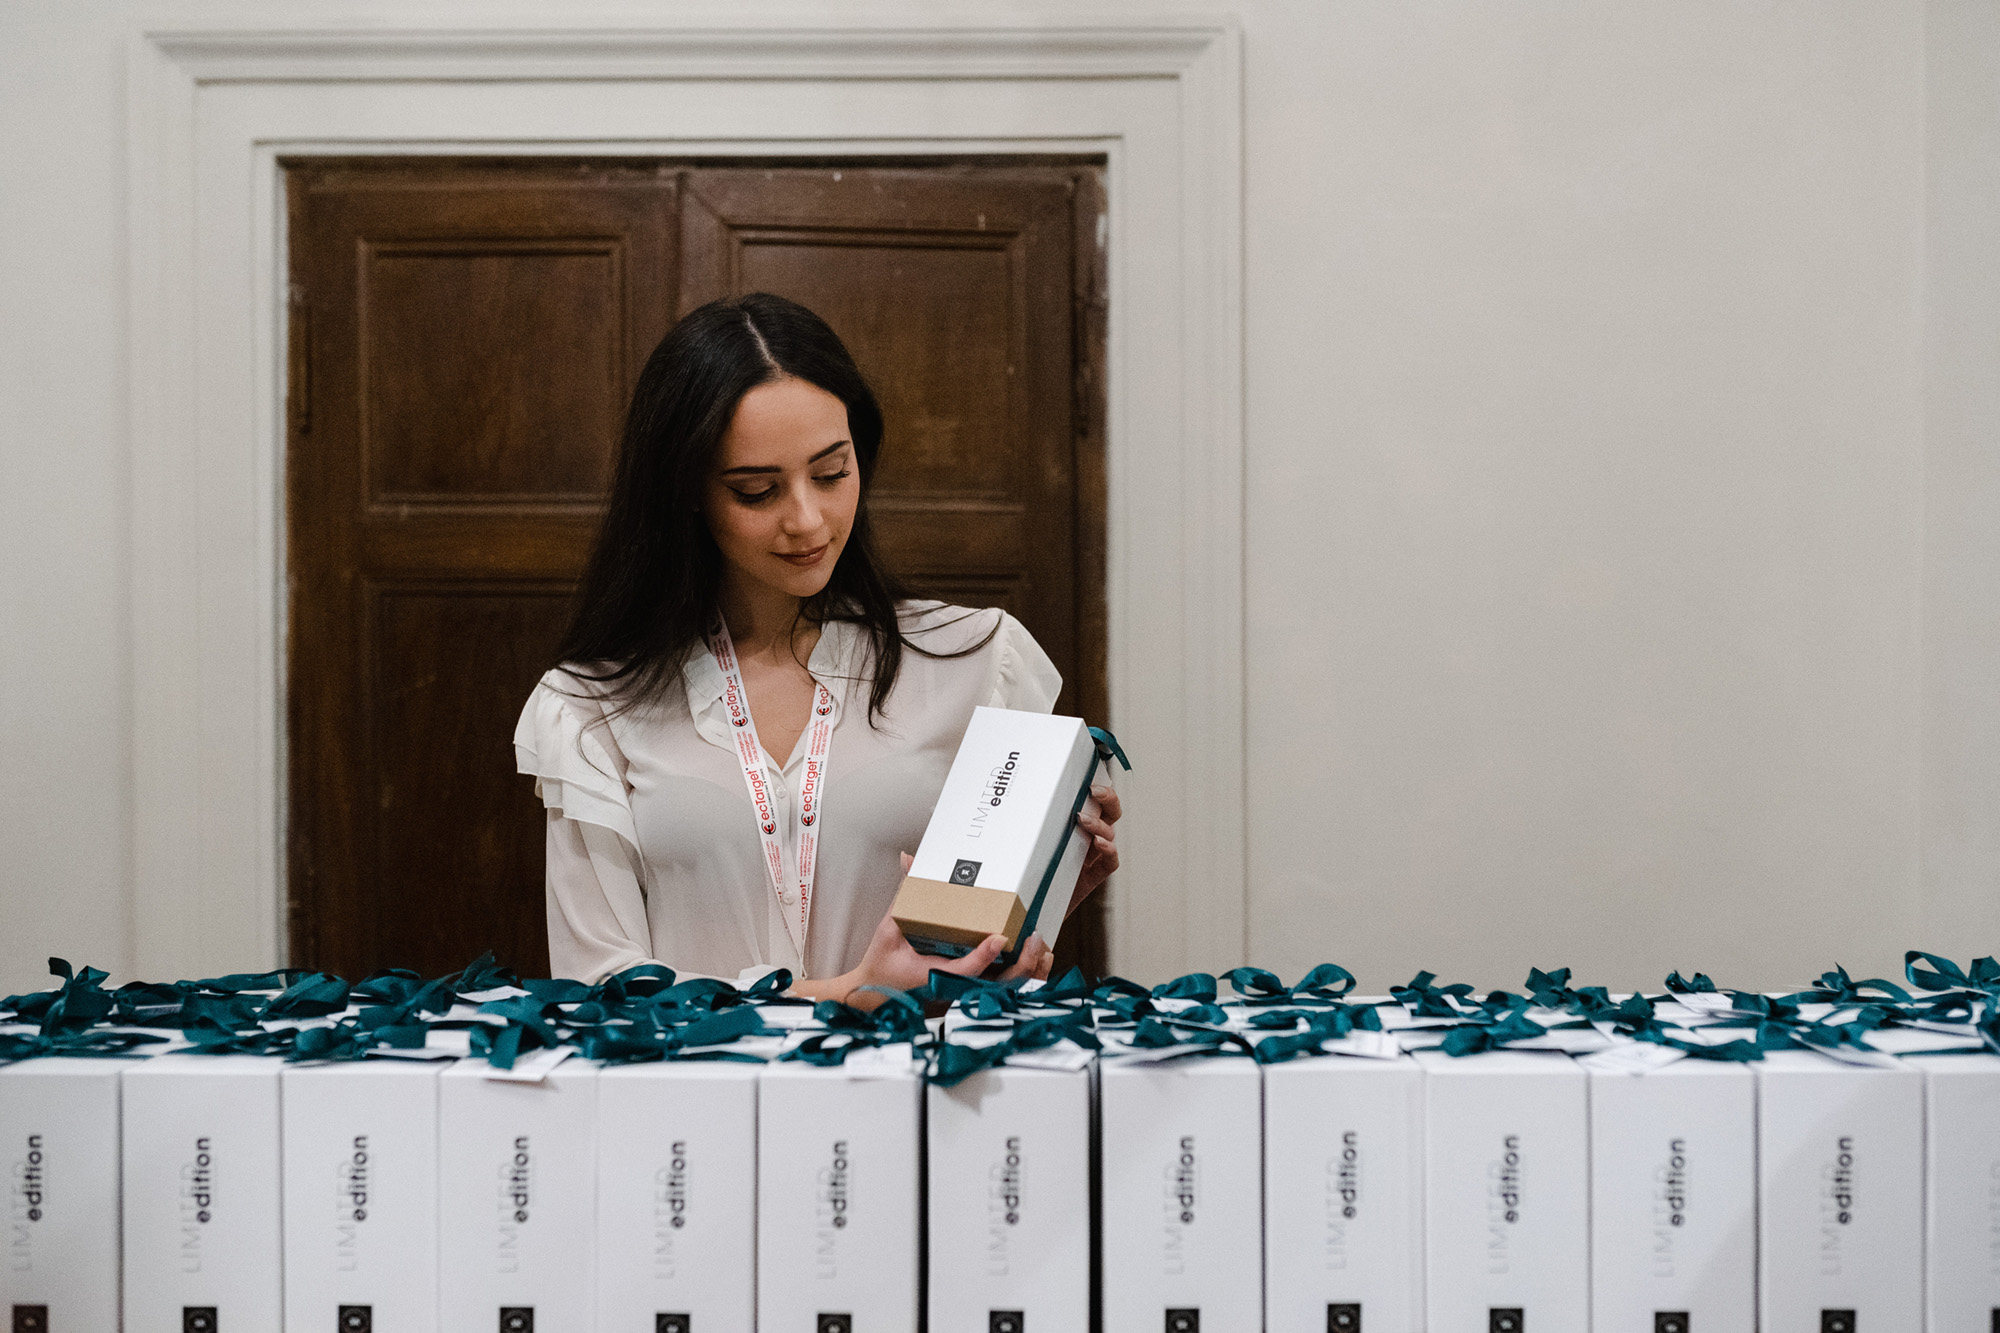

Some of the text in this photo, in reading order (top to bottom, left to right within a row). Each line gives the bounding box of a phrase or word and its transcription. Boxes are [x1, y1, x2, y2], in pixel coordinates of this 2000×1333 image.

[747, 769, 770, 821] ecTarget
[802, 760, 818, 812] ecTarget
[966, 766, 1005, 838] LIMITED
[990, 751, 1020, 807] edition
[23, 1134, 42, 1222] edition
[191, 1137, 211, 1223] edition
[349, 1135, 367, 1222] edition
[510, 1136, 529, 1223] edition
[667, 1140, 686, 1229] edition
[829, 1140, 848, 1229] edition
[1002, 1136, 1020, 1225] edition
[1175, 1136, 1194, 1224] edition
[1337, 1130, 1357, 1219] edition
[1500, 1134, 1519, 1224] edition
[1667, 1137, 1685, 1227] edition
[1835, 1136, 1852, 1225] edition
